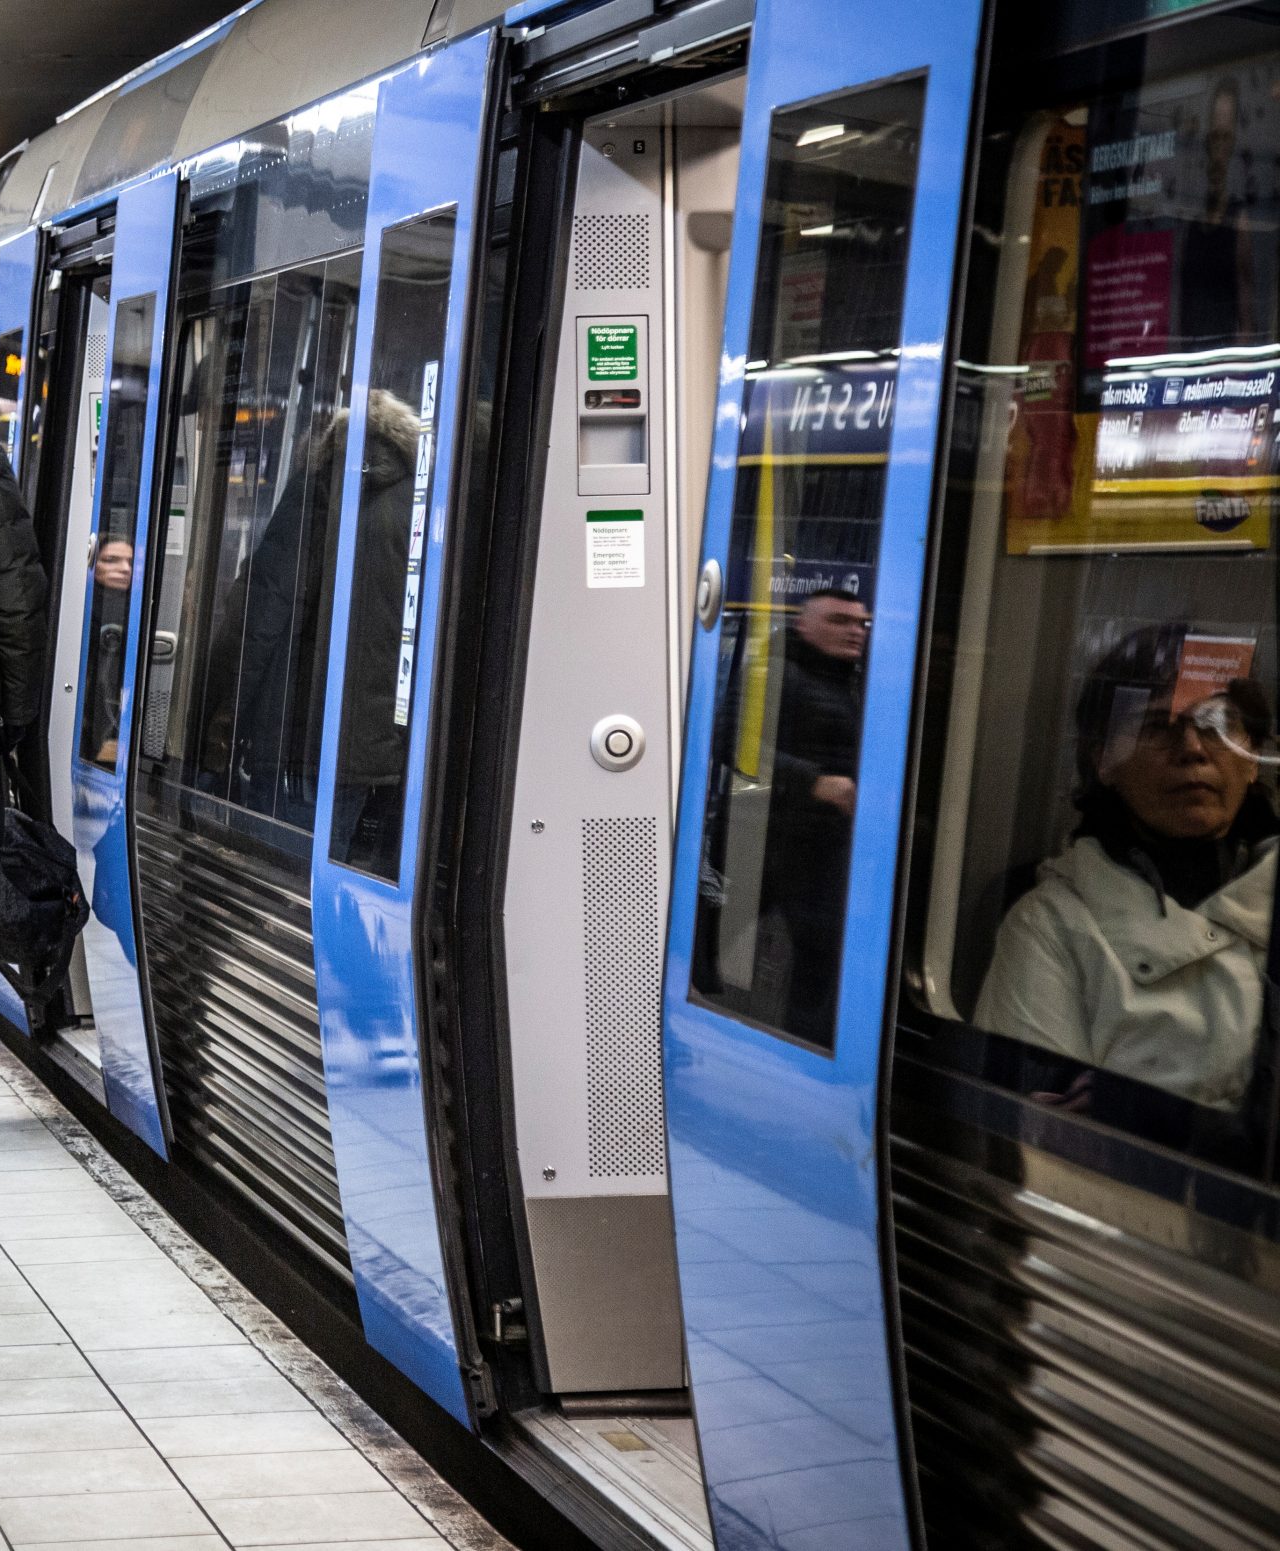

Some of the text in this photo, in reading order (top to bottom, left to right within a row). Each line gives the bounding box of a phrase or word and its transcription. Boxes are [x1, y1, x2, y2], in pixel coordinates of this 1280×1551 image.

[636, 142, 643, 151] 5
[591, 327, 634, 336] Nödöppnare
[607, 334, 630, 342] dörrar
[1195, 496, 1252, 522] FANTA
